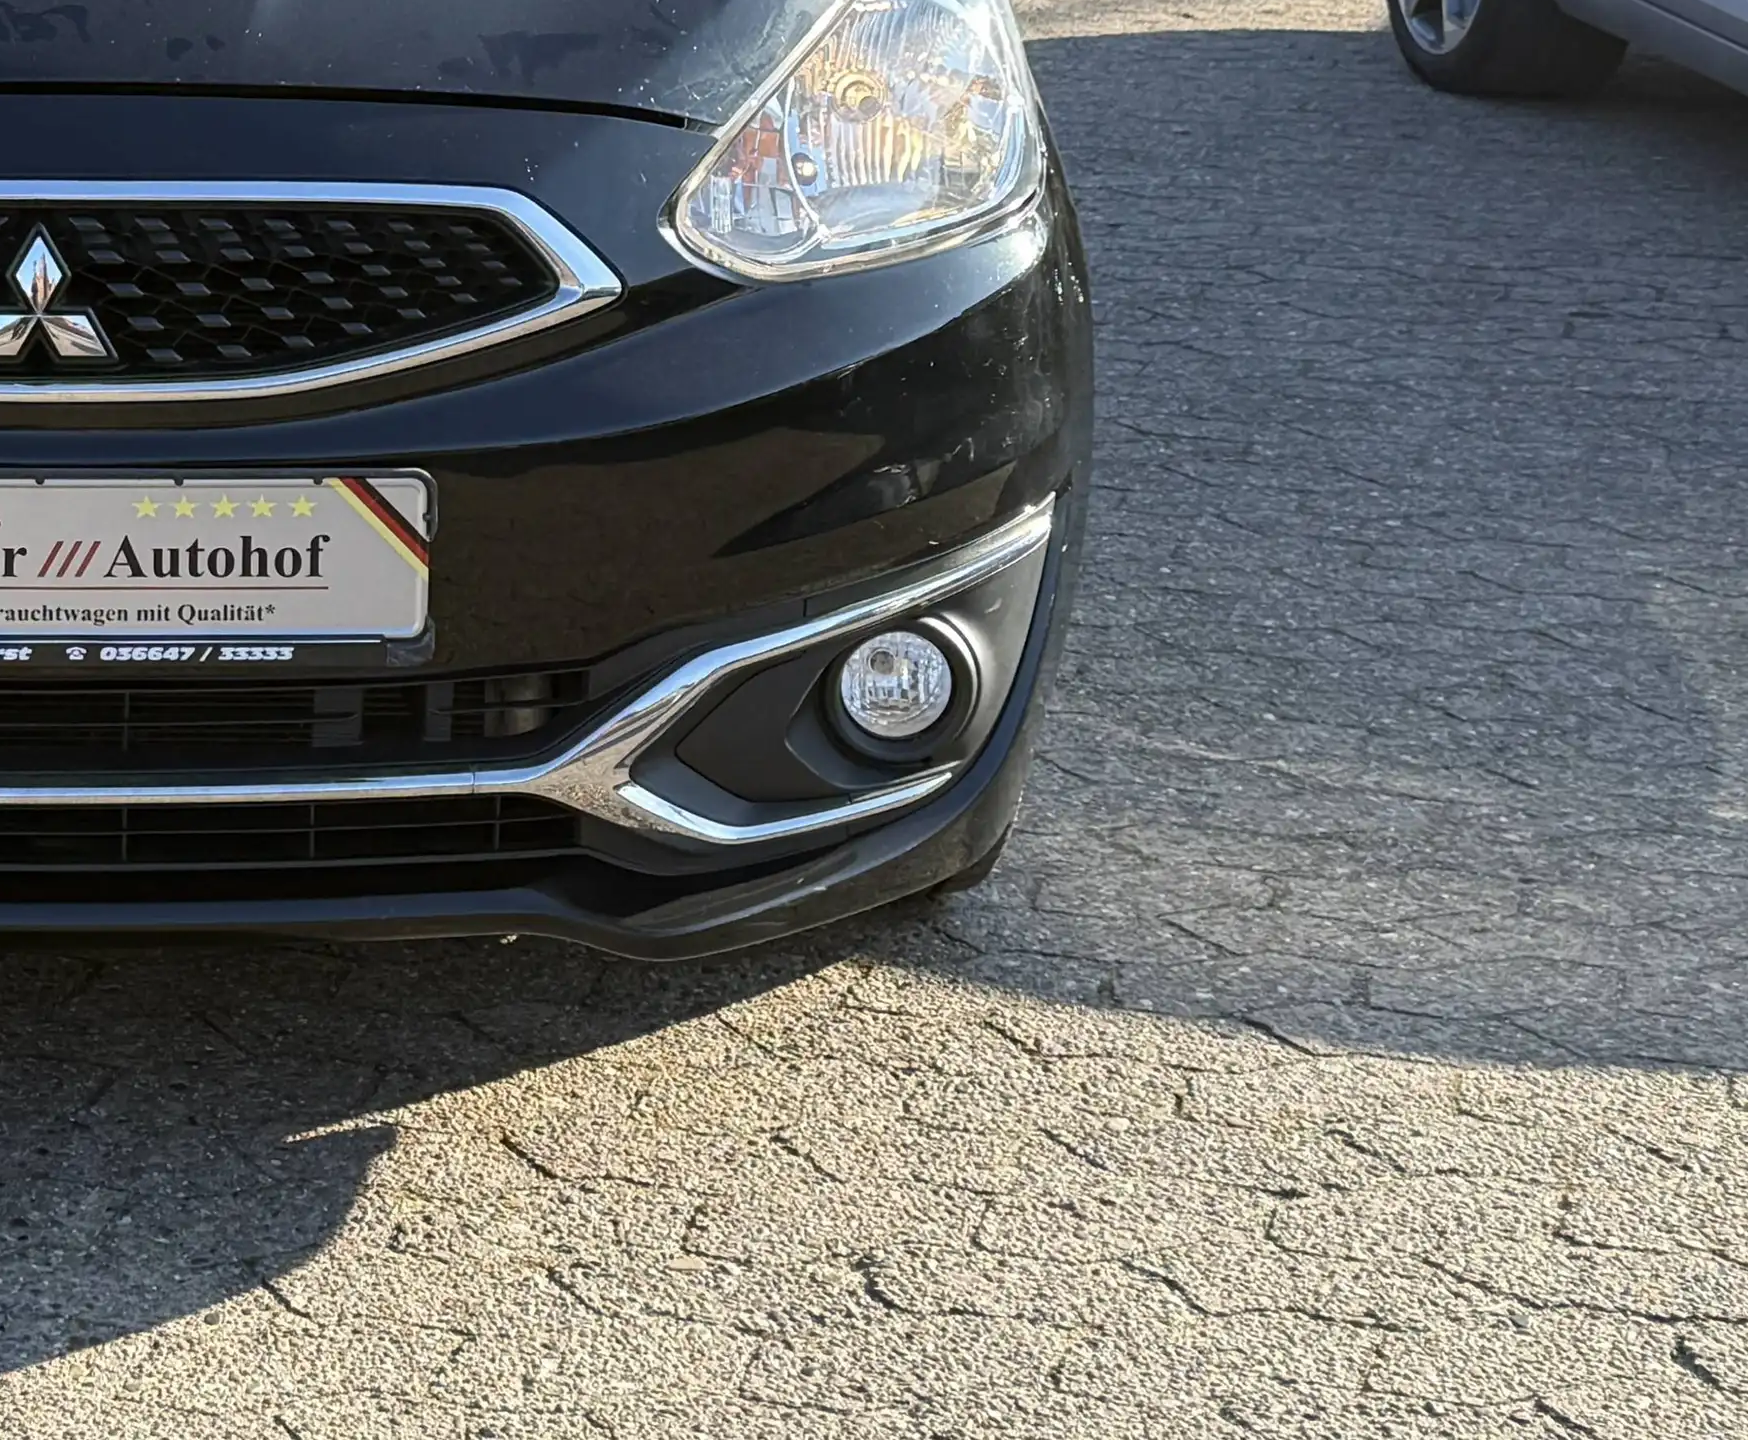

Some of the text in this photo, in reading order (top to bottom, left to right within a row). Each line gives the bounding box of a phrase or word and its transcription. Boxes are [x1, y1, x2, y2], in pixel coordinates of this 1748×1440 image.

[103, 534, 331, 578] Autohof
[137, 604, 170, 622] mit
[99, 646, 196, 661] 036647
[218, 646, 294, 661] 33333
